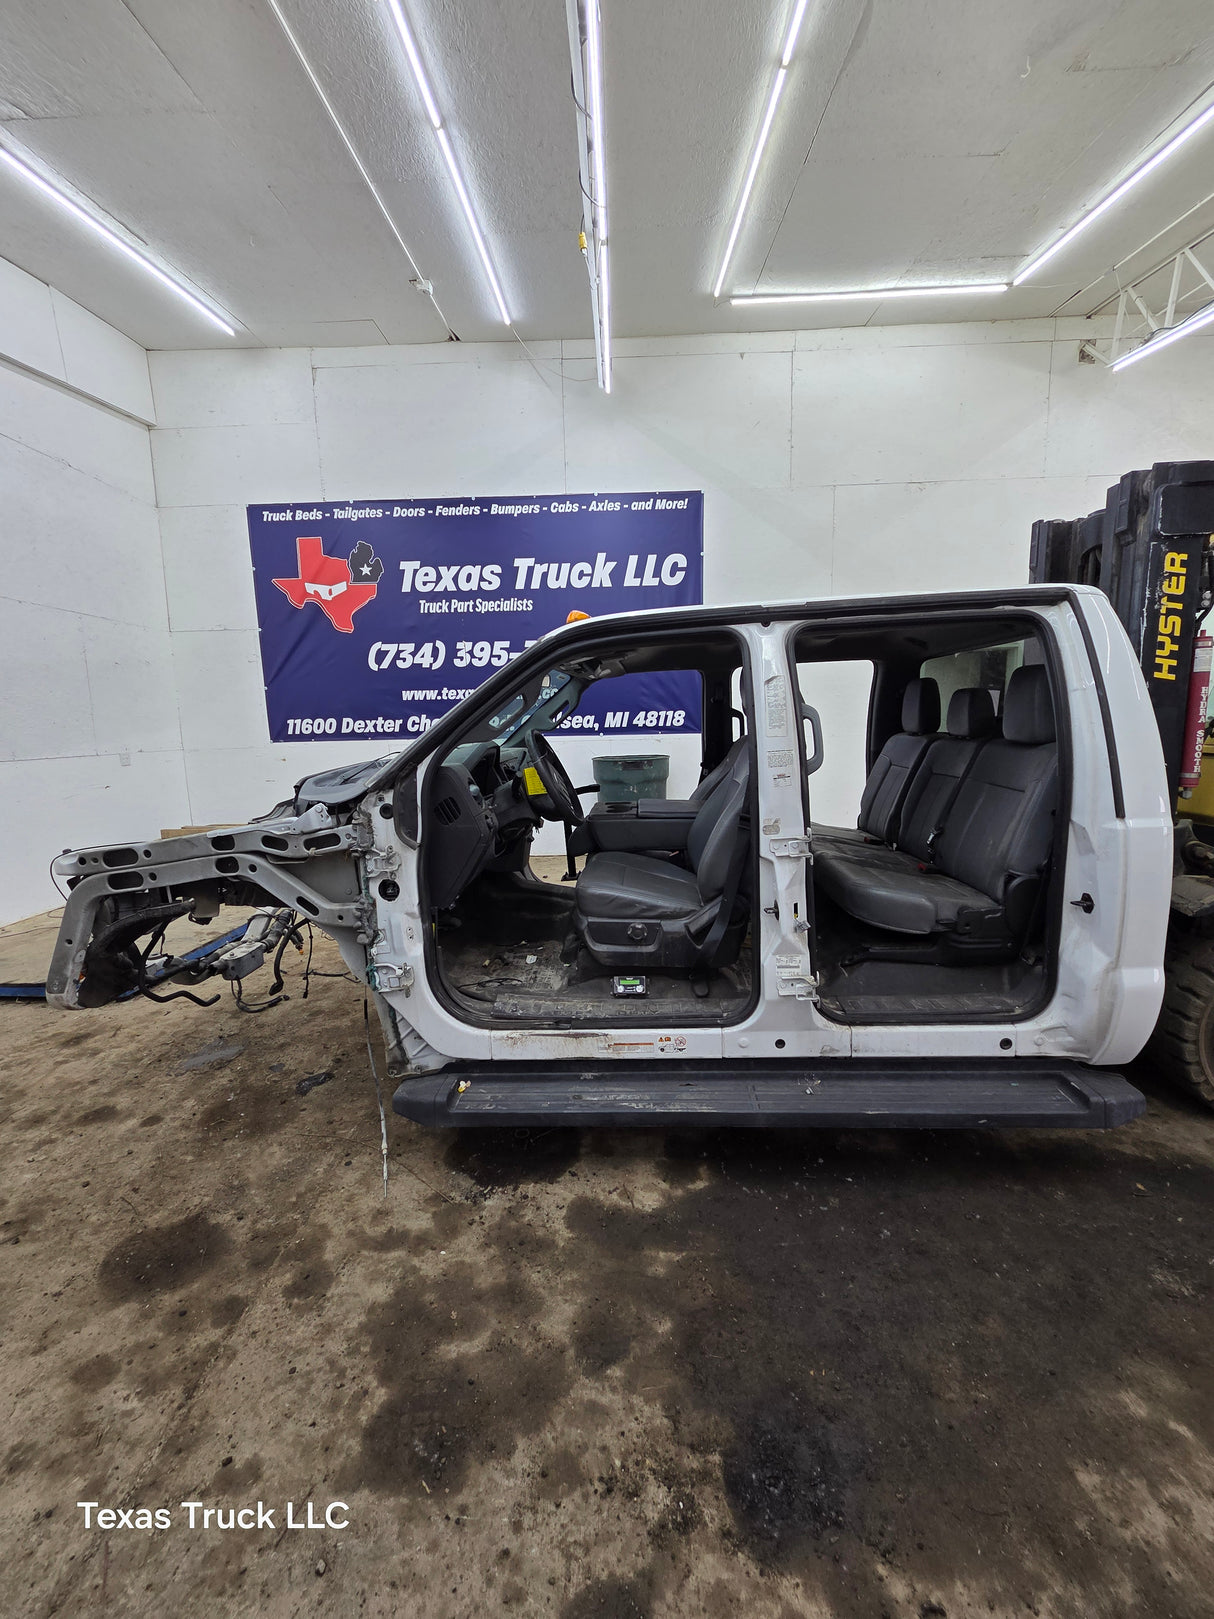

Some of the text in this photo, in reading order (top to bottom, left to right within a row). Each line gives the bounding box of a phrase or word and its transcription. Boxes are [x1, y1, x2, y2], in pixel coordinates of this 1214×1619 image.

[262, 509, 294, 521] Truck
[295, 508, 323, 520] Beds
[333, 506, 383, 521] Tailgates
[393, 506, 426, 517] Doors
[435, 504, 481, 516] Fenders
[490, 503, 541, 517] Bumpers
[550, 501, 579, 513] Cabs
[588, 500, 621, 512] Axles
[631, 499, 652, 511] and
[654, 498, 689, 510] More!
[399, 552, 688, 593] Texas Truck LLC
[419, 597, 534, 614] Truck Part Specialists
[1153, 551, 1189, 680] HYSTER
[367, 639, 446, 671] (734)
[286, 718, 337, 735] 11600
[341, 716, 403, 733] Dexter
[604, 711, 630, 728] MI
[632, 710, 686, 727] 48118
[1193, 687, 1208, 773] HYDRA SMOOTH
